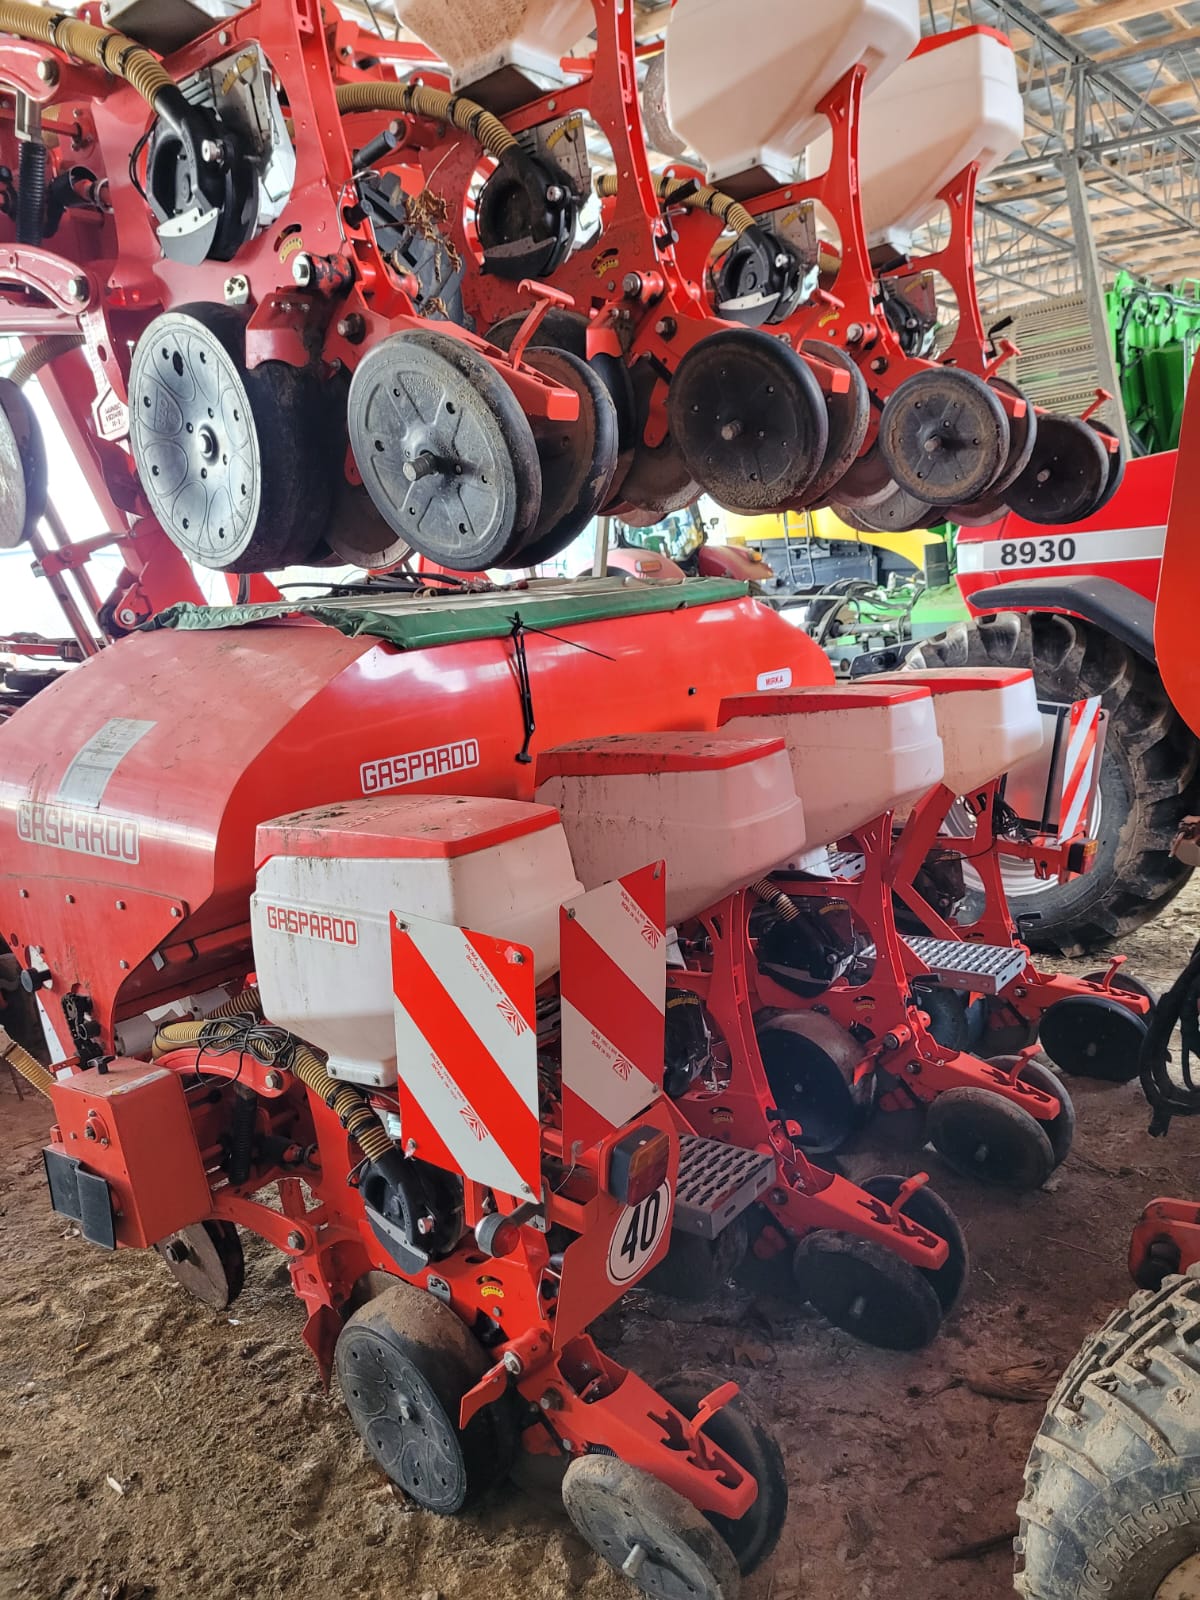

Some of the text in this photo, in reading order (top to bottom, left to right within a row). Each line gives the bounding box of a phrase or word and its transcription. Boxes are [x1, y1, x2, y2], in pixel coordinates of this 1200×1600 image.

[1001, 538, 1076, 566] 8930
[362, 741, 478, 791] GASPARDO
[19, 804, 138, 860] GASPARDO
[267, 906, 357, 945] GASPARDO
[620, 1190, 660, 1264] 40
